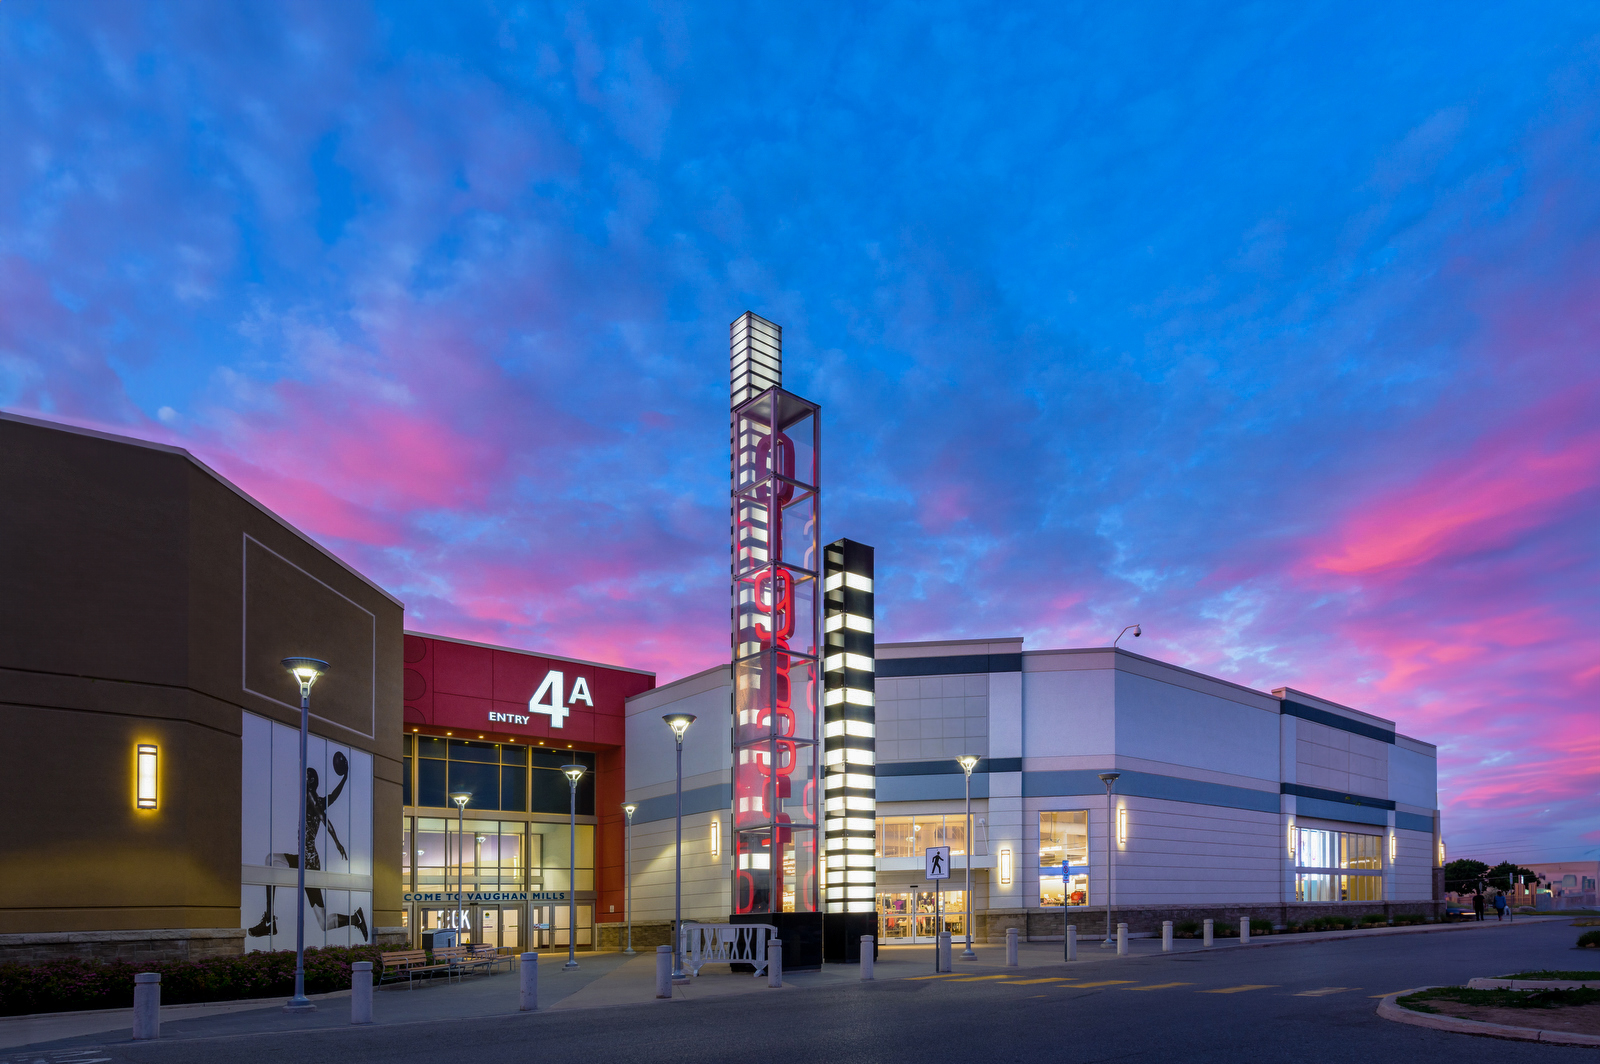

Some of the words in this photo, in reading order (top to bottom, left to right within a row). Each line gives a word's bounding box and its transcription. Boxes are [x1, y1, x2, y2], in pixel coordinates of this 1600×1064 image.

[488, 711, 530, 725] ENTRY
[467, 892, 527, 901] VAUGHAN
[532, 892, 565, 900] MILLS
